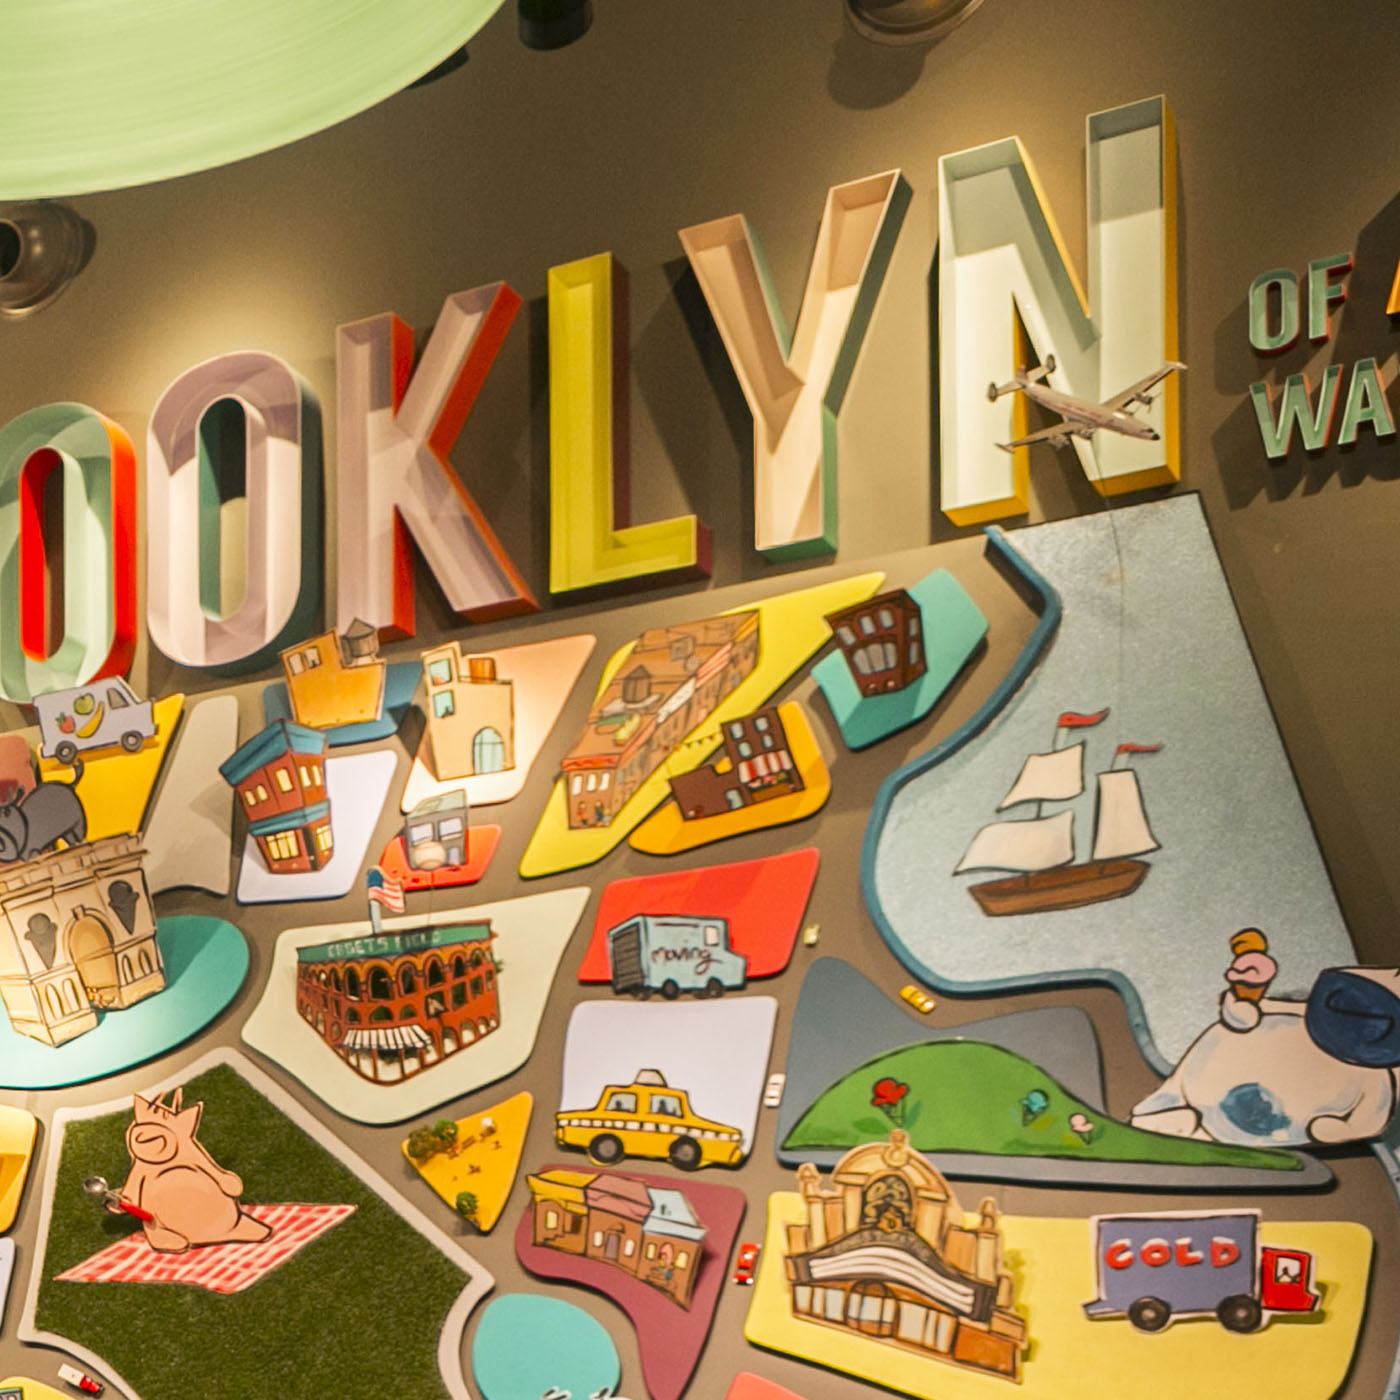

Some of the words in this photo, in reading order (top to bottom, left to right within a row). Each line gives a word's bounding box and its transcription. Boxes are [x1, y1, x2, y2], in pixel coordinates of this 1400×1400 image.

[1249, 252, 1354, 355] OF
[1249, 357, 1399, 460] WA
[1104, 1236, 1241, 1270] COLD
